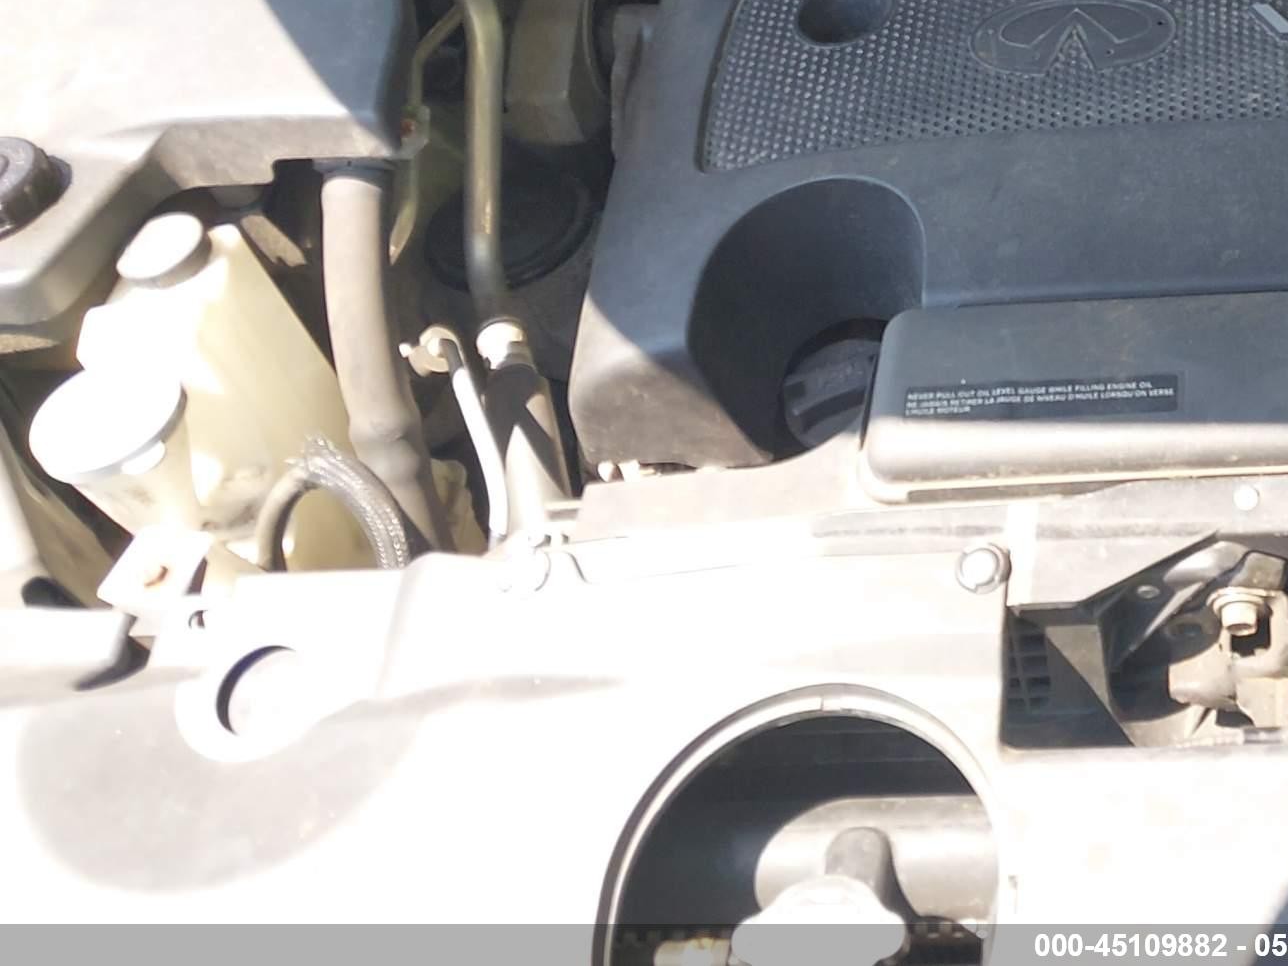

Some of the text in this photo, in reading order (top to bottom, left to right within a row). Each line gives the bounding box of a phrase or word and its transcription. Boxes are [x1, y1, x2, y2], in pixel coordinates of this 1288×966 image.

[936, 391, 955, 399] PULL
[958, 390, 976, 398] OUT
[976, 389, 990, 397] OIL
[992, 387, 1016, 395] LEVEL
[1018, 386, 1046, 394] GAUGE
[1075, 382, 1105, 391] FILLING
[1107, 381, 1137, 390] ENGINE
[1139, 381, 1153, 389] OIL
